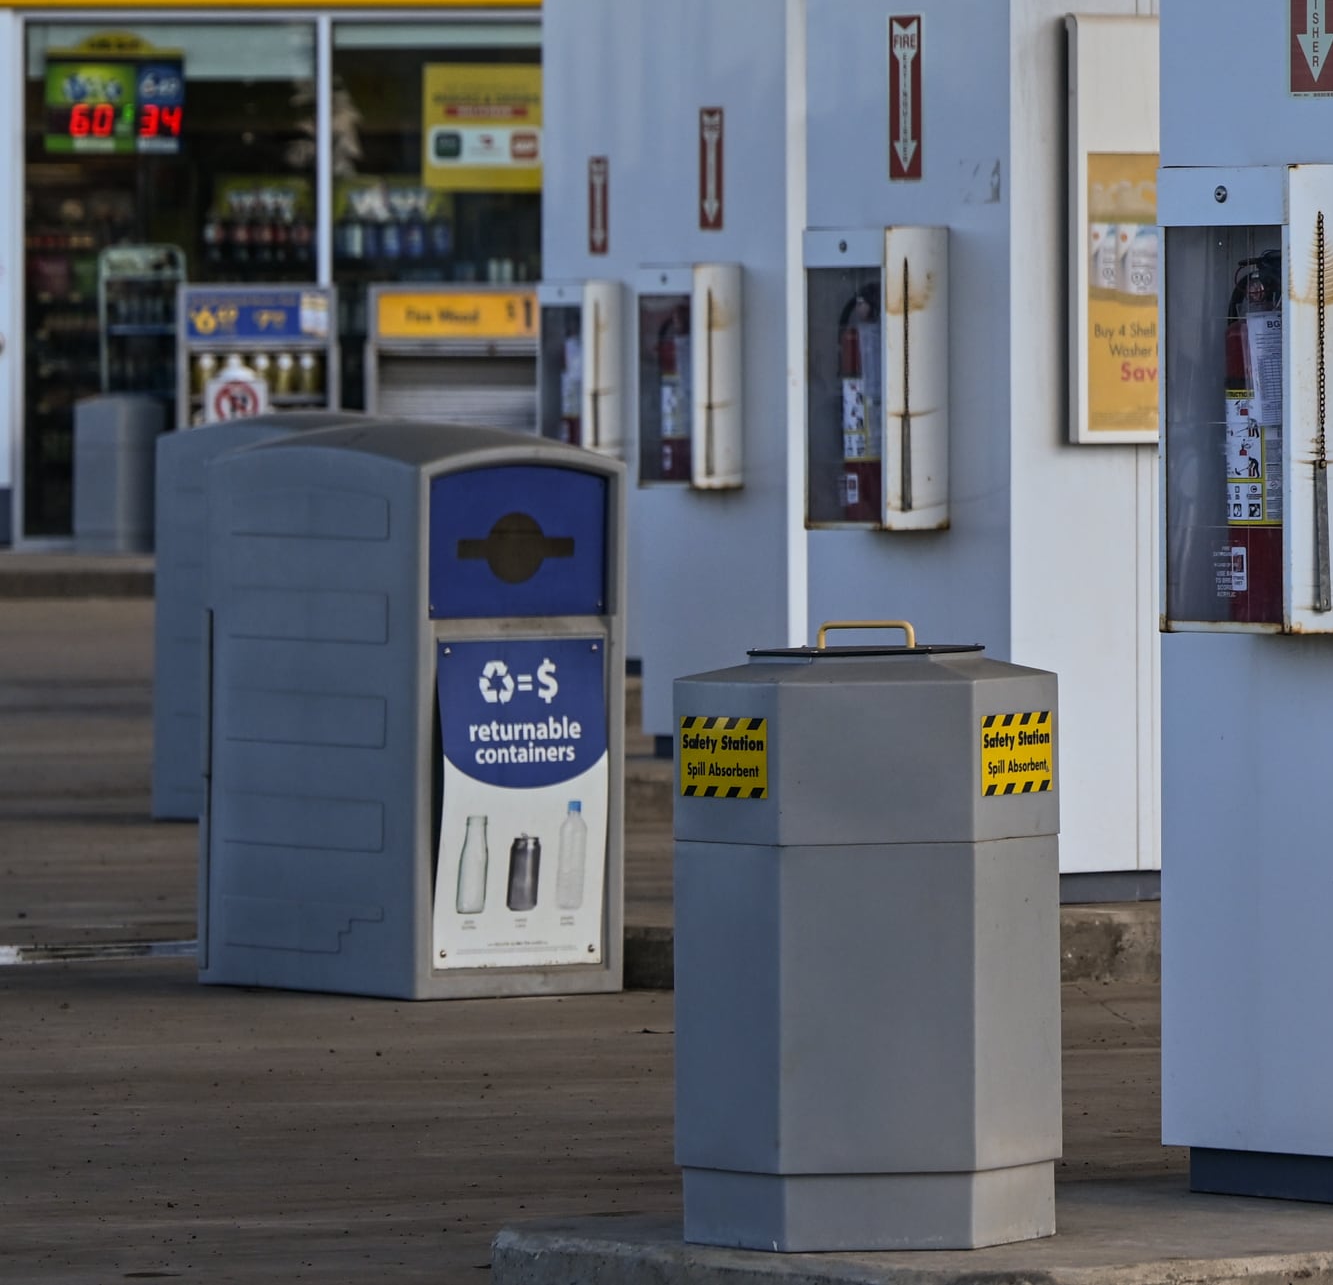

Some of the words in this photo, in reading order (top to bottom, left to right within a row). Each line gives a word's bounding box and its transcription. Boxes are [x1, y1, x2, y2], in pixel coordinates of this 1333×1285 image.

[894, 33, 917, 49] FIRE
[1095, 323, 1113, 339] Buy
[1119, 324, 1126, 336] 4
[1130, 321, 1156, 337] Shell
[1109, 342, 1152, 356] Washer
[1121, 362, 1158, 381] Sav
[469, 716, 581, 742] returnable
[682, 733, 718, 754] Safety
[721, 735, 764, 751] Station
[983, 731, 1015, 751] Safety
[1018, 728, 1050, 745] Station
[475, 741, 575, 764] containers
[687, 762, 706, 779] Spill
[709, 762, 759, 777] Absorbent
[988, 759, 1005, 778] Spill
[1008, 757, 1047, 773] Absorbent
